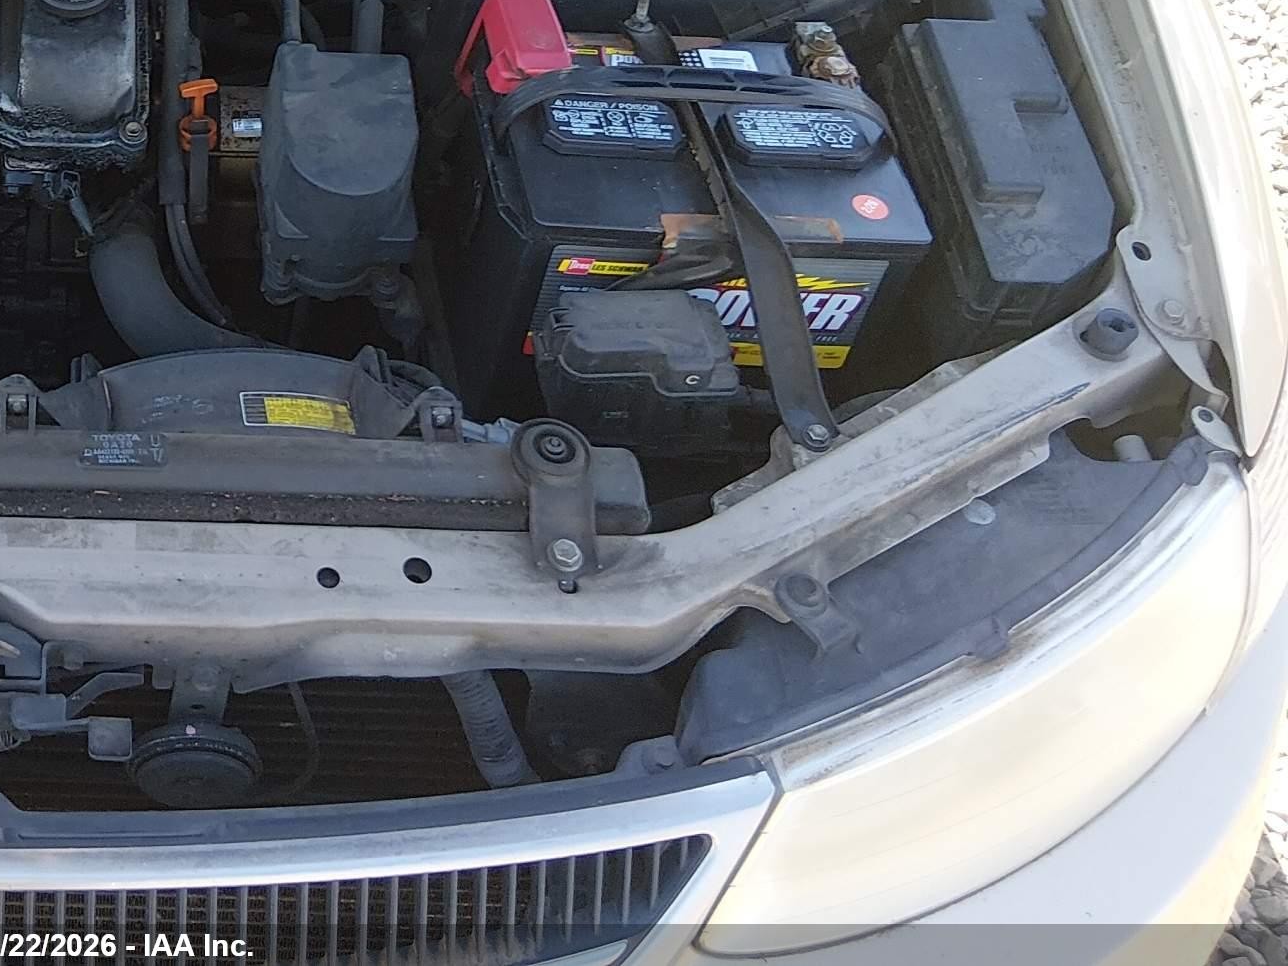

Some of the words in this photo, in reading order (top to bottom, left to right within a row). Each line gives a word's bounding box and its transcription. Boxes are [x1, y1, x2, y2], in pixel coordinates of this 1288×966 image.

[564, 99, 609, 109] DANGER
[618, 102, 659, 112] POISON
[591, 264, 606, 272] LES
[92, 433, 141, 441] TOYOTA
